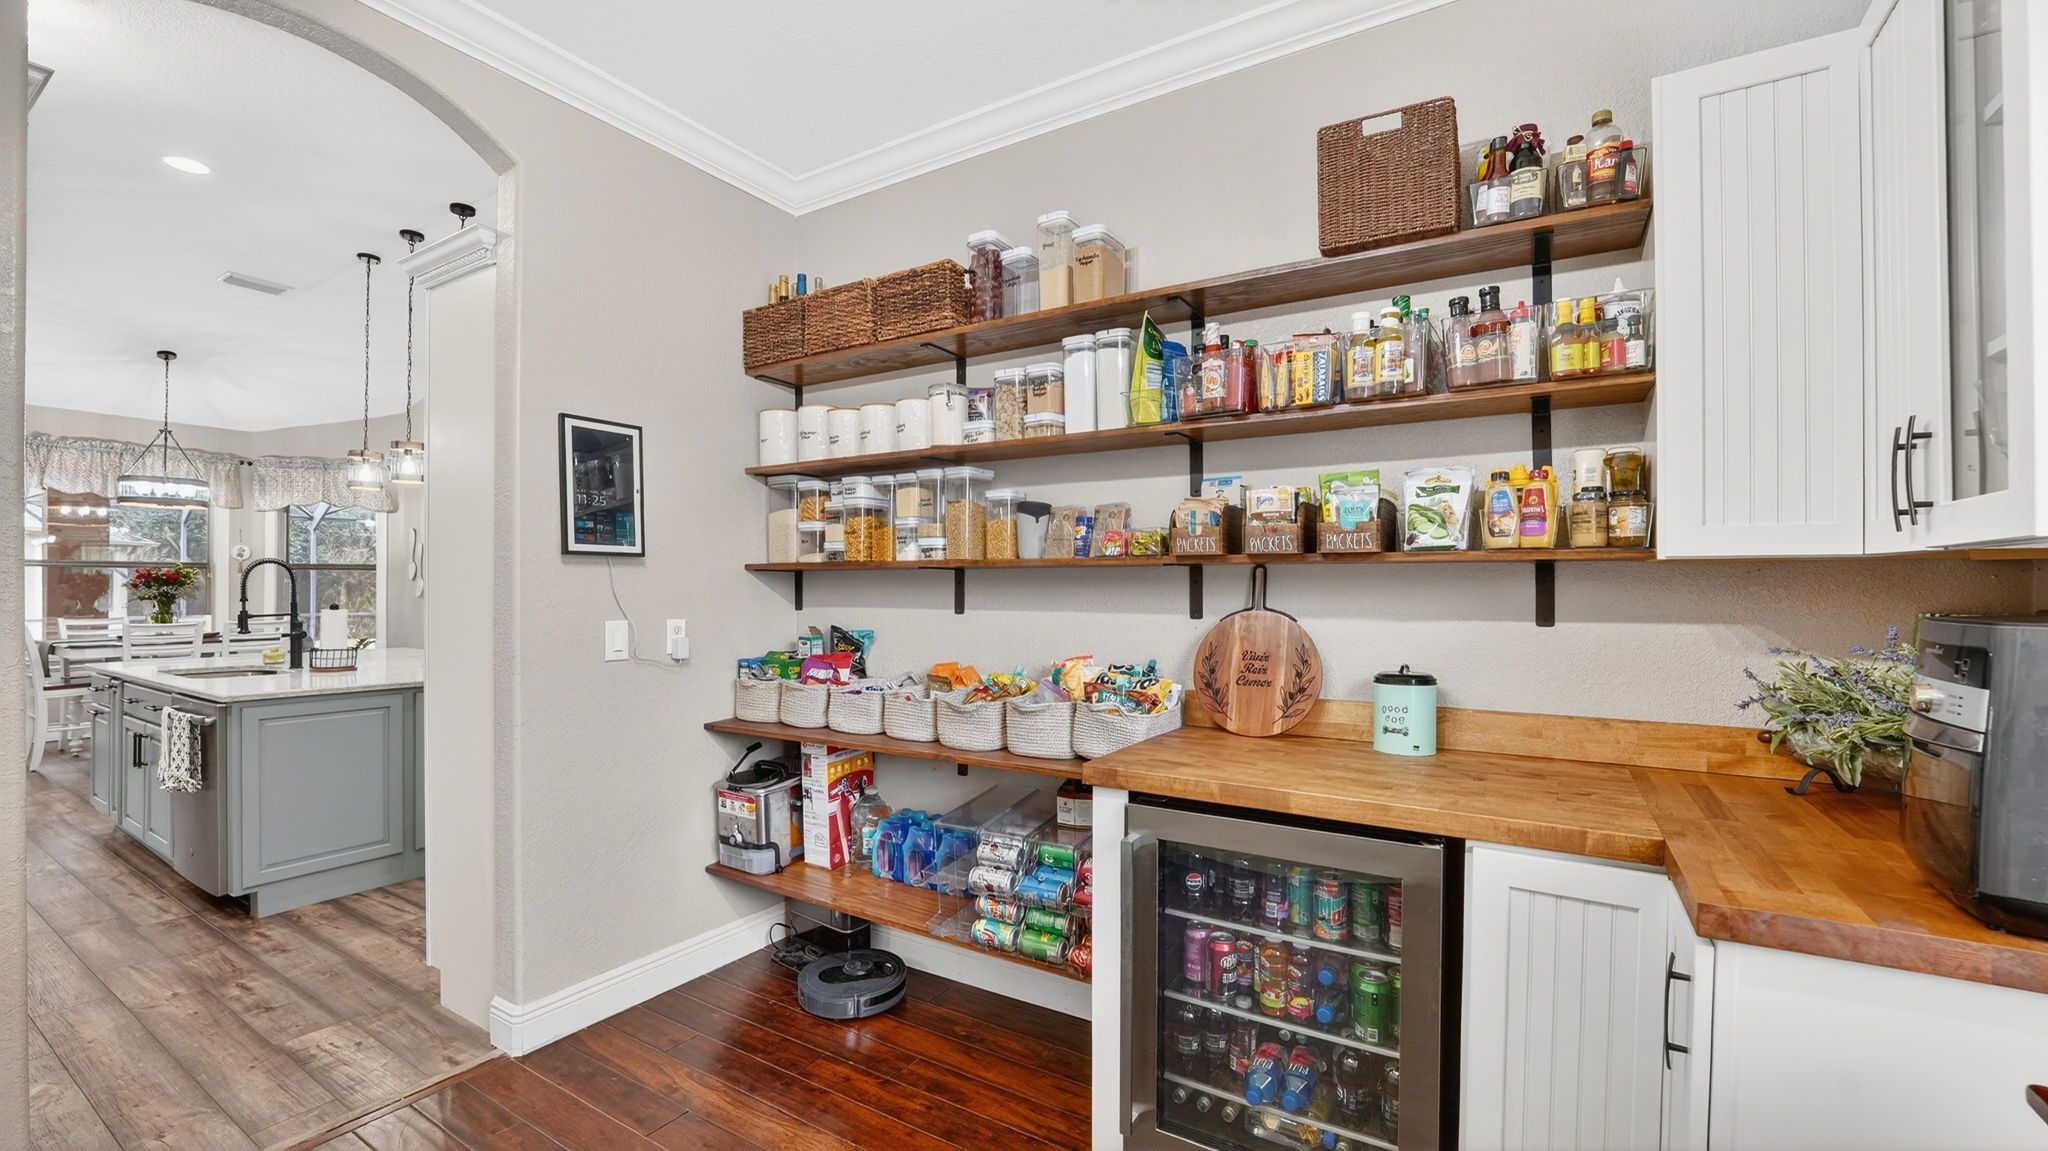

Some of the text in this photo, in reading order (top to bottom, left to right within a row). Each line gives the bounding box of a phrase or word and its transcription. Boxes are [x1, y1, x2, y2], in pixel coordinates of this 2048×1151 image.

[576, 494, 607, 507] 11:25
[1176, 537, 1216, 552] PACKETS
[1249, 535, 1293, 552] PACKETS
[1326, 532, 1372, 550] PACKETS
